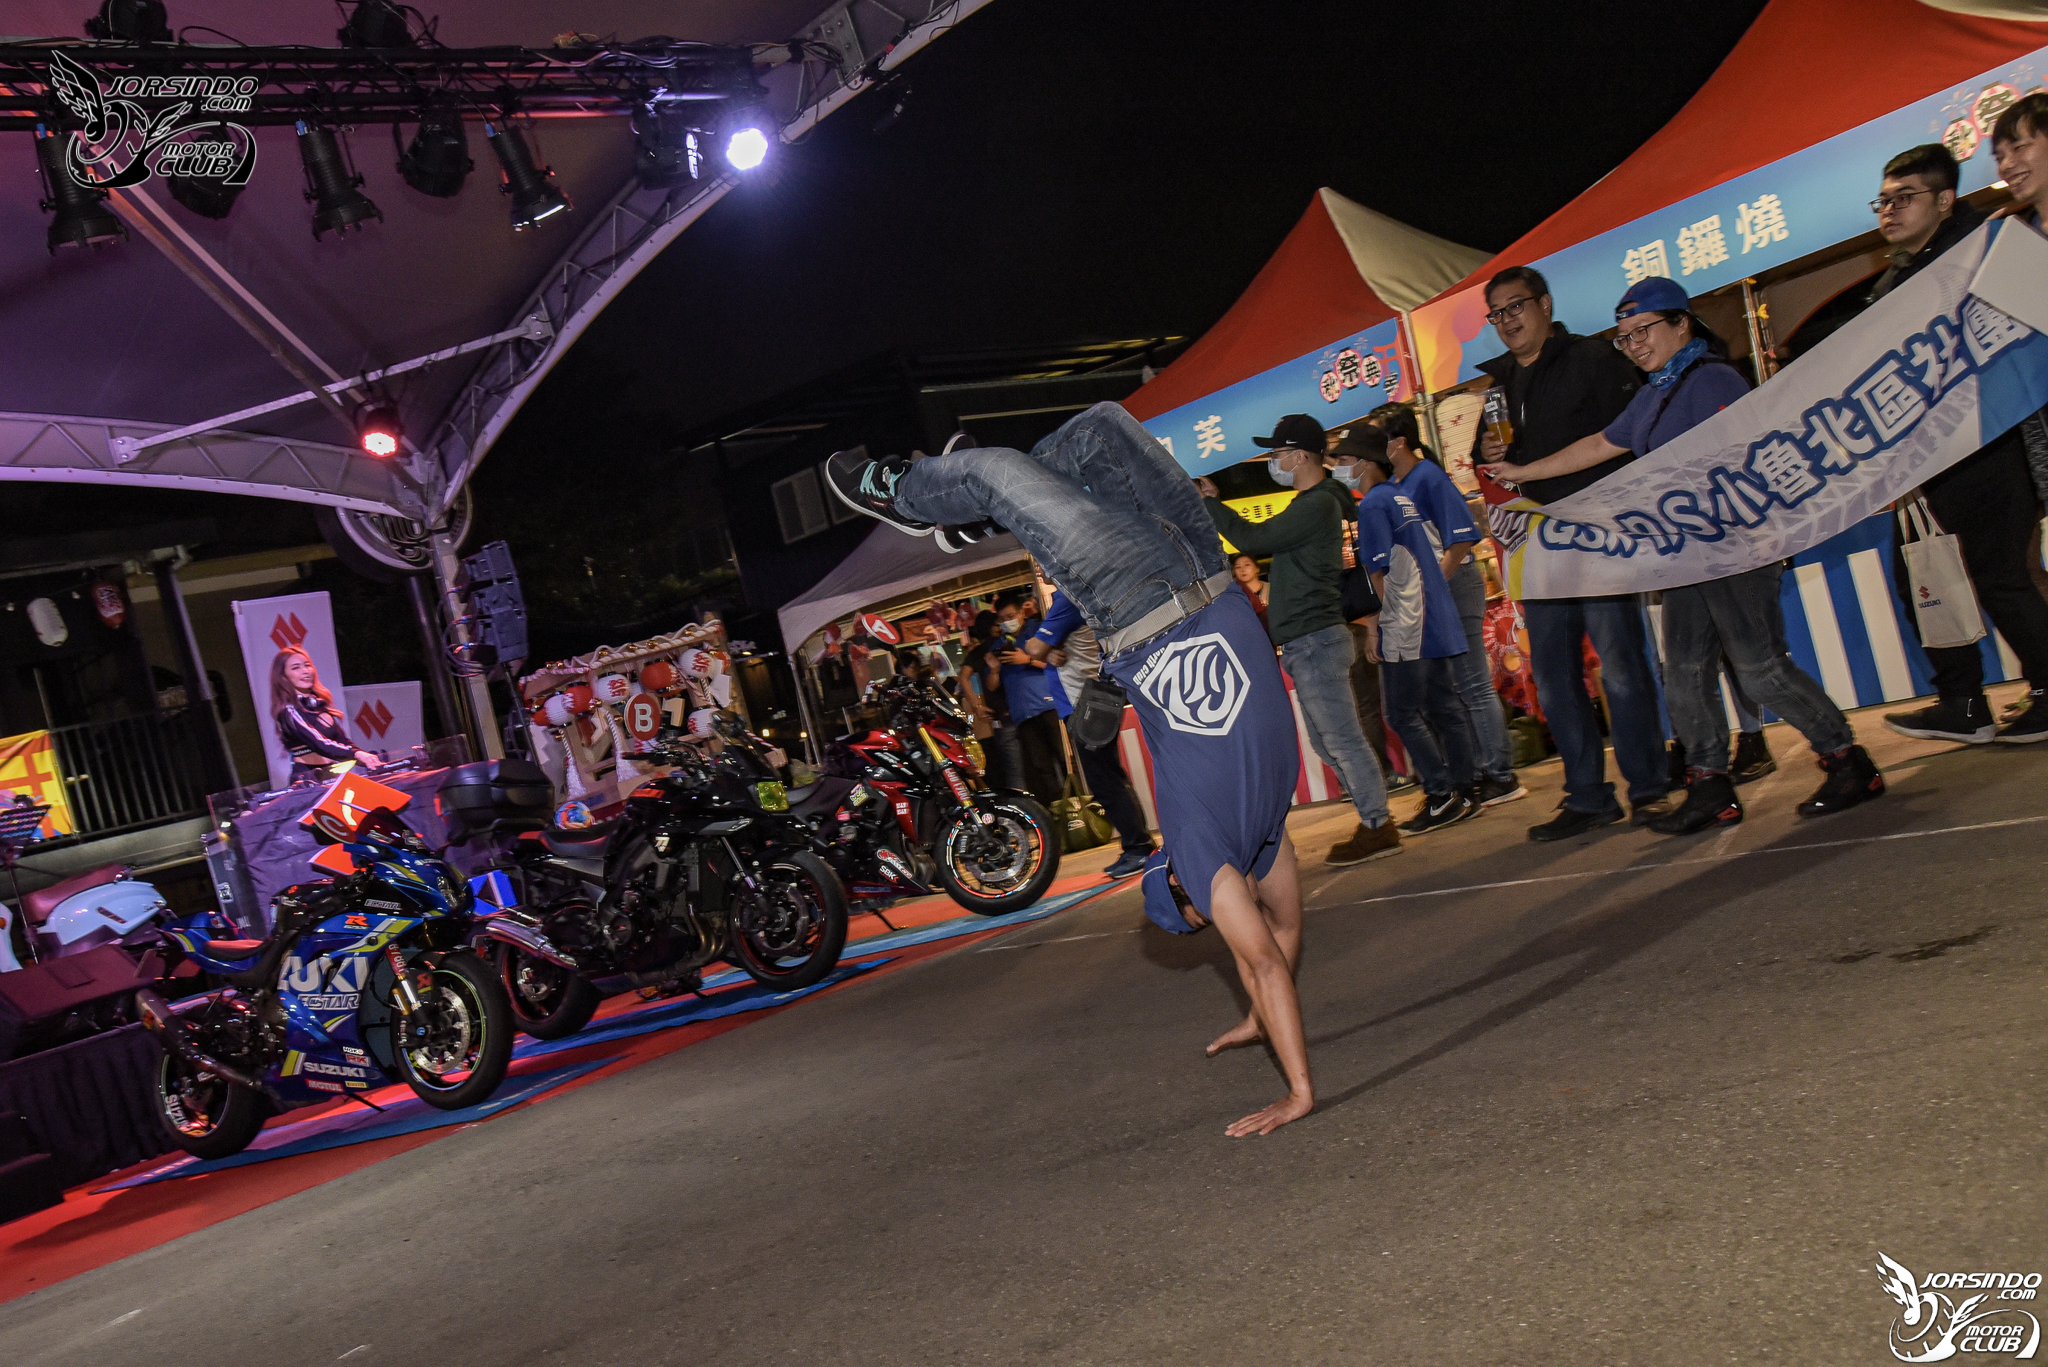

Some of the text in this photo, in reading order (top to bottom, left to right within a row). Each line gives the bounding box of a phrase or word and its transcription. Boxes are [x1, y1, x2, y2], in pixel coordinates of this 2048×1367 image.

[1621, 193, 1790, 287] 銅鑼燒
[1918, 599, 1942, 609] SUZUKI
[634, 703, 654, 733] B
[320, 814, 348, 837] C
[879, 865, 898, 880] SBK
[303, 1061, 367, 1078] SUZUKI
